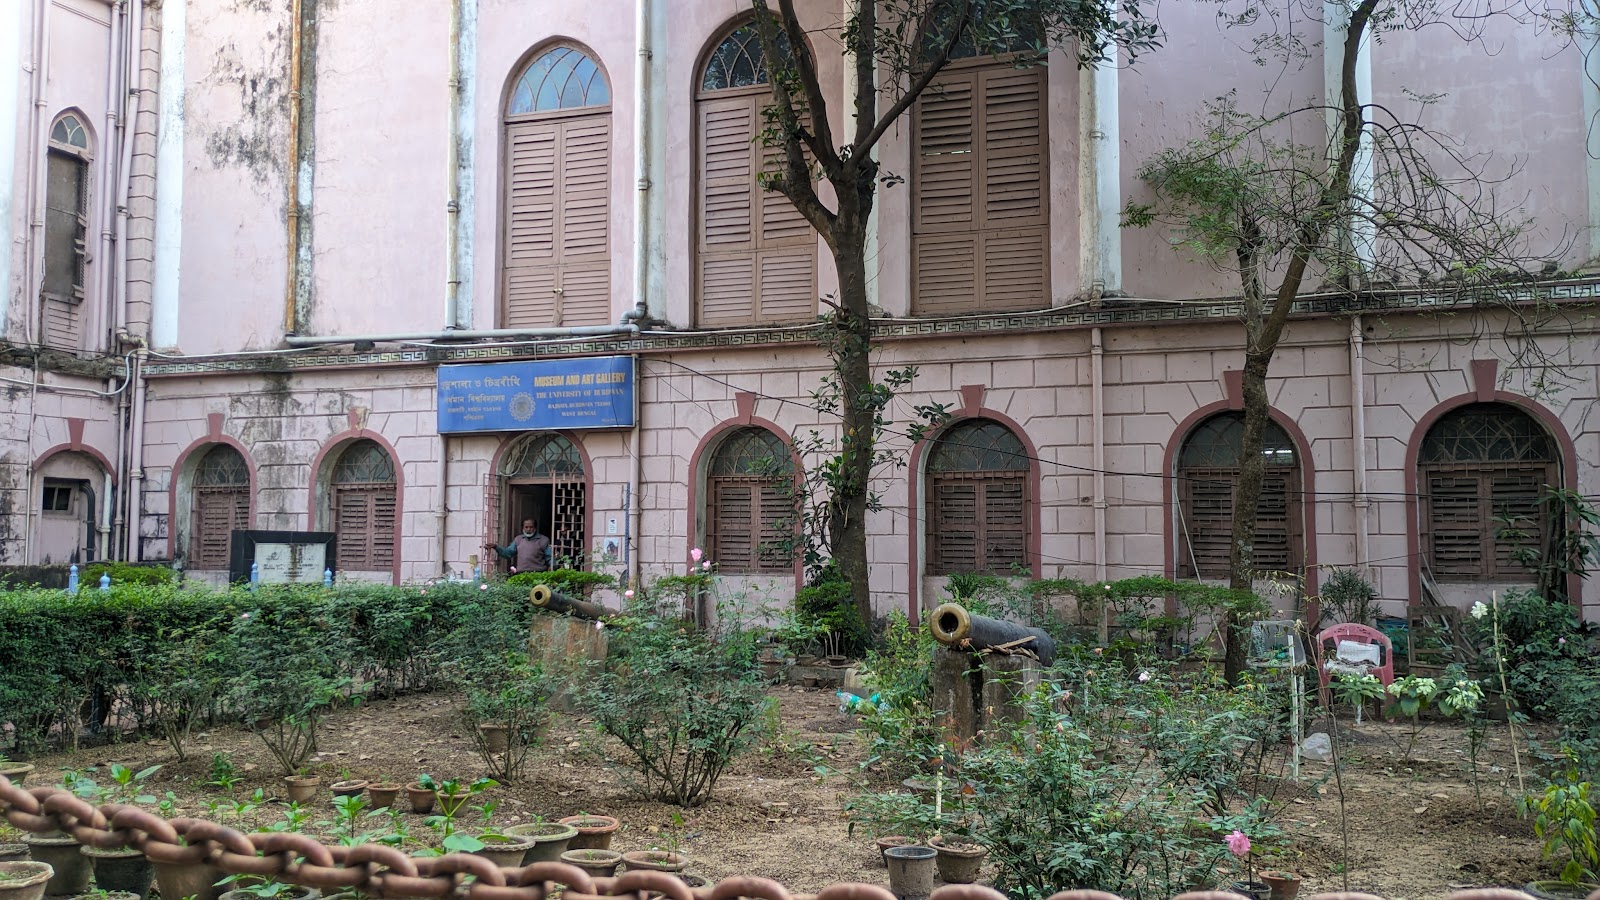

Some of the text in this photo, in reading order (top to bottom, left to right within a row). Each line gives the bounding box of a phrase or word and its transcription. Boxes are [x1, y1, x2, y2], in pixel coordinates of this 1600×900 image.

[474, 379, 481, 388] ও
[534, 372, 626, 387] MUSEUM AND ART GALLERY
[536, 388, 625, 399] THE UNIVERSITY OF BURDWAN
